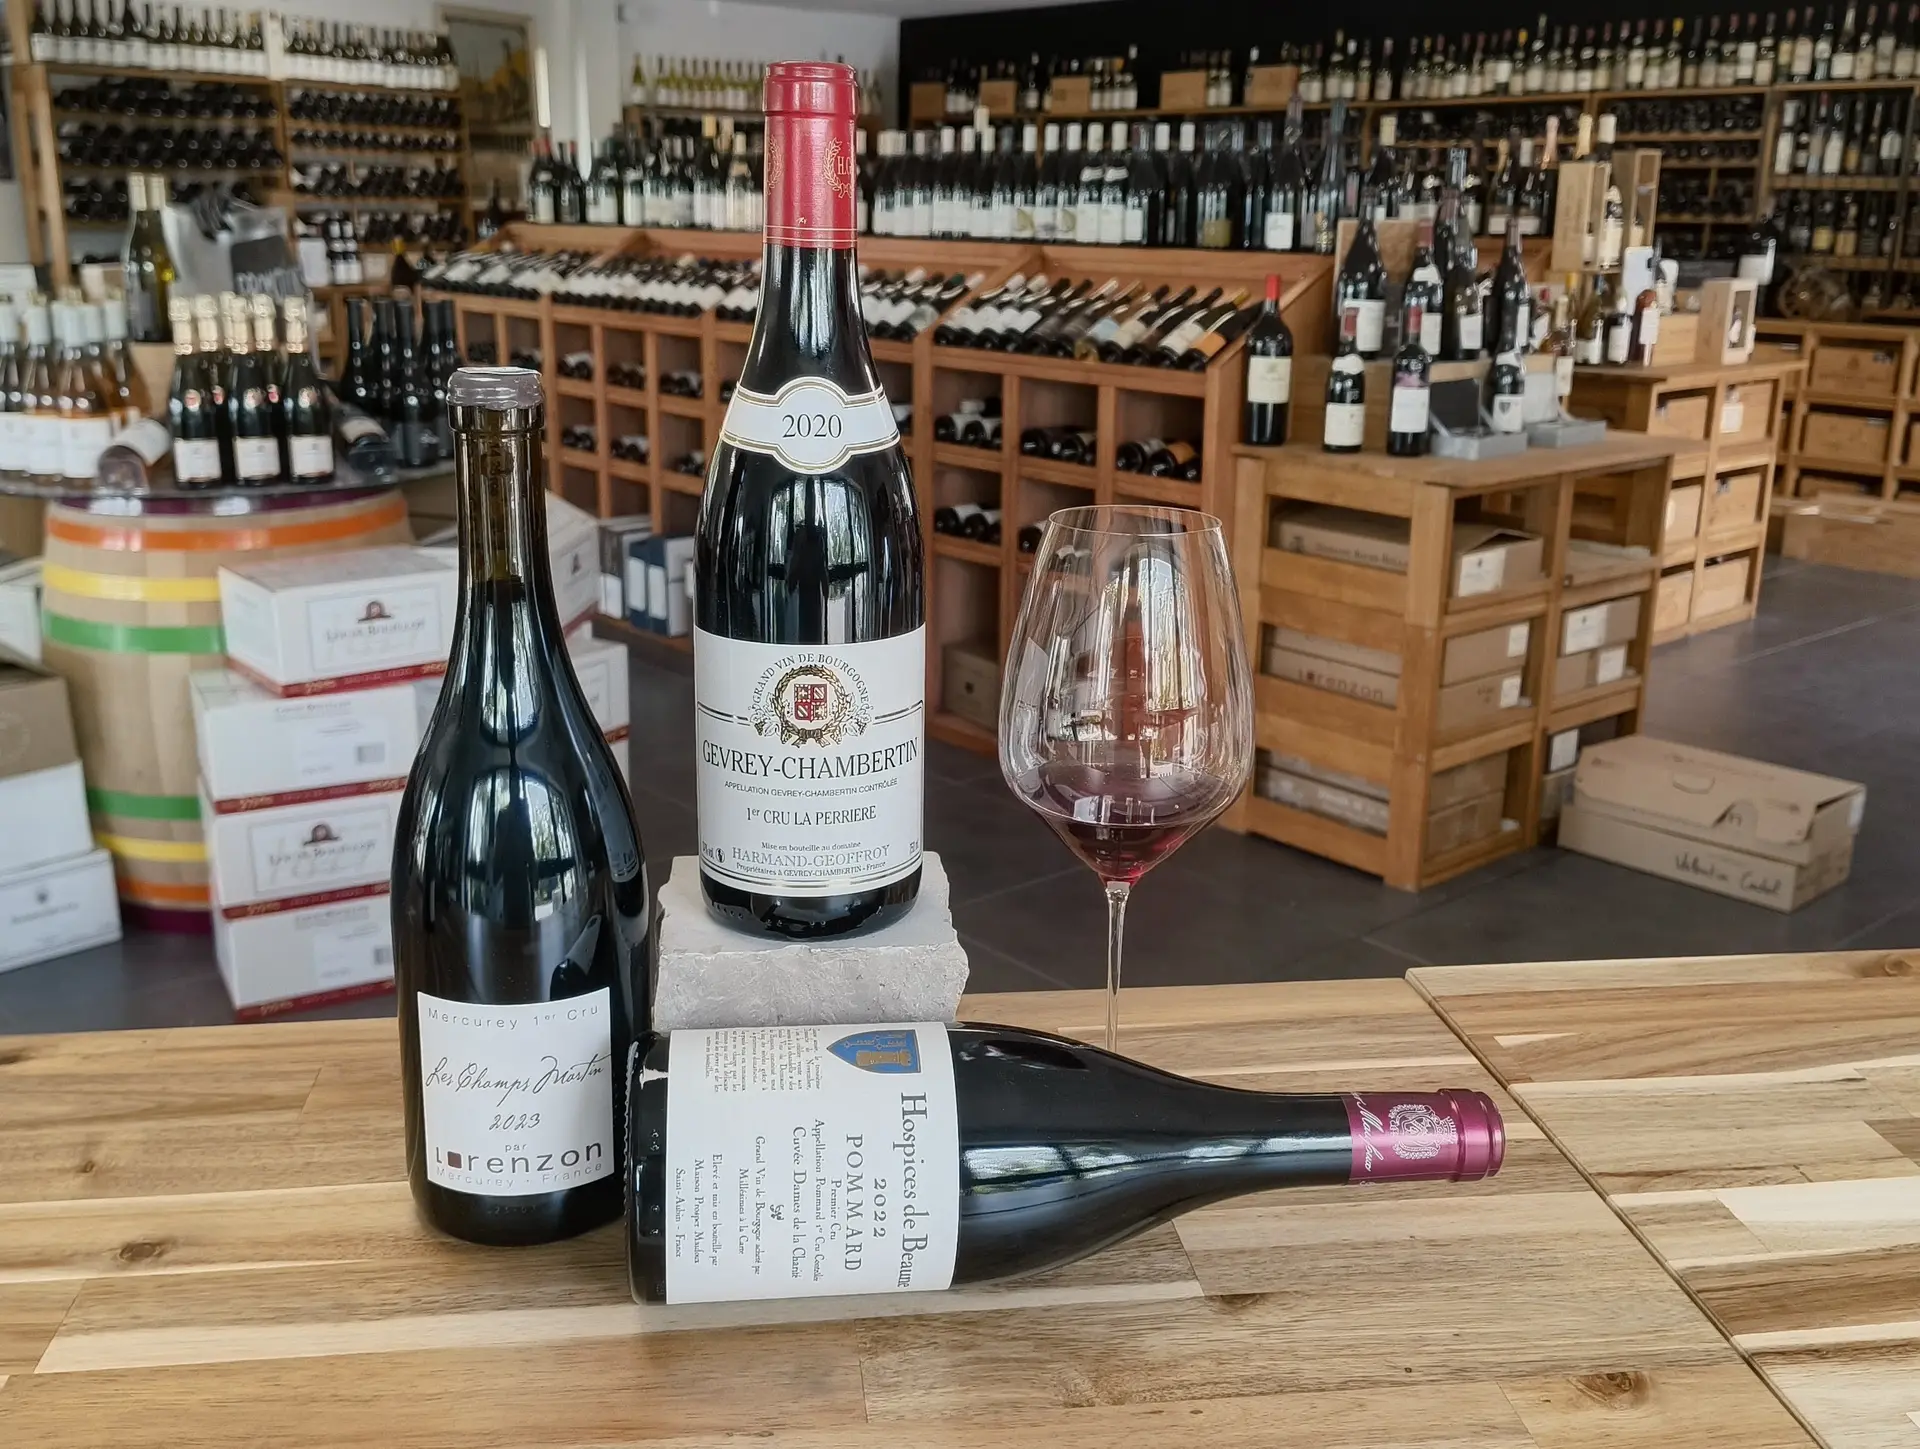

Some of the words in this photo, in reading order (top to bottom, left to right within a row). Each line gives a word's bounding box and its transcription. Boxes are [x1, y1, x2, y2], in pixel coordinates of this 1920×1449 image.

[783, 414, 841, 439] 2020
[752, 667, 775, 702] GRAND
[775, 654, 795, 669] VIN
[799, 653, 814, 662] DE
[818, 654, 869, 703] BOURGOGNE
[703, 737, 919, 779] GEVREY-CHAMBERTIN
[725, 781, 770, 795] APPELLATION
[771, 787, 857, 797] GEVREY-CHAMBERTIN
[859, 778, 898, 794] CONTRÔLÉE
[747, 807, 760, 820] 1er
[764, 810, 790, 825] CRU
[794, 811, 811, 826] LA
[816, 806, 876, 825] PERRIERE
[732, 844, 890, 867] HARMAND-GEOFFROY
[762, 842, 777, 850] Mise
[789, 843, 820, 851] bouteille
[832, 841, 861, 850] domaine
[866, 861, 886, 870] France
[428, 1008, 519, 1030] Mercurey
[568, 1005, 599, 1021] Cru
[426, 1057, 454, 1087] Les
[456, 1062, 531, 1107] Champs
[533, 1053, 611, 1094] Martin
[489, 1113, 541, 1131] 2023
[505, 1143, 528, 1152] par
[755, 1136, 765, 1163] Grand
[793, 1127, 807, 1165] Cuvée
[811, 1119, 825, 1172] Appellation
[893, 1092, 928, 1200] Hospices
[437, 1166, 514, 1187] Mercurey
[542, 1162, 602, 1183] France
[694, 1159, 704, 1193] Maison
[755, 1168, 765, 1185] Vin
[675, 1168, 686, 1222] Saint-Aubin
[739, 1168, 749, 1214] Millésimes
[755, 1188, 765, 1198] de
[793, 1170, 807, 1213] Dames
[815, 1177, 826, 1220] Pommard
[831, 1178, 842, 1220] Premier
[844, 1134, 864, 1271] POMMARD
[691, 1197, 704, 1228] Prosper
[752, 1202, 765, 1241] Bourgogne
[873, 1178, 886, 1238] 2022
[903, 1204, 930, 1232] de
[793, 1217, 807, 1230] de
[830, 1222, 841, 1240] Cru
[793, 1234, 806, 1243] la
[814, 1236, 825, 1251] Cru
[791, 1247, 806, 1278] Charité
[898, 1233, 928, 1288] Beaune
